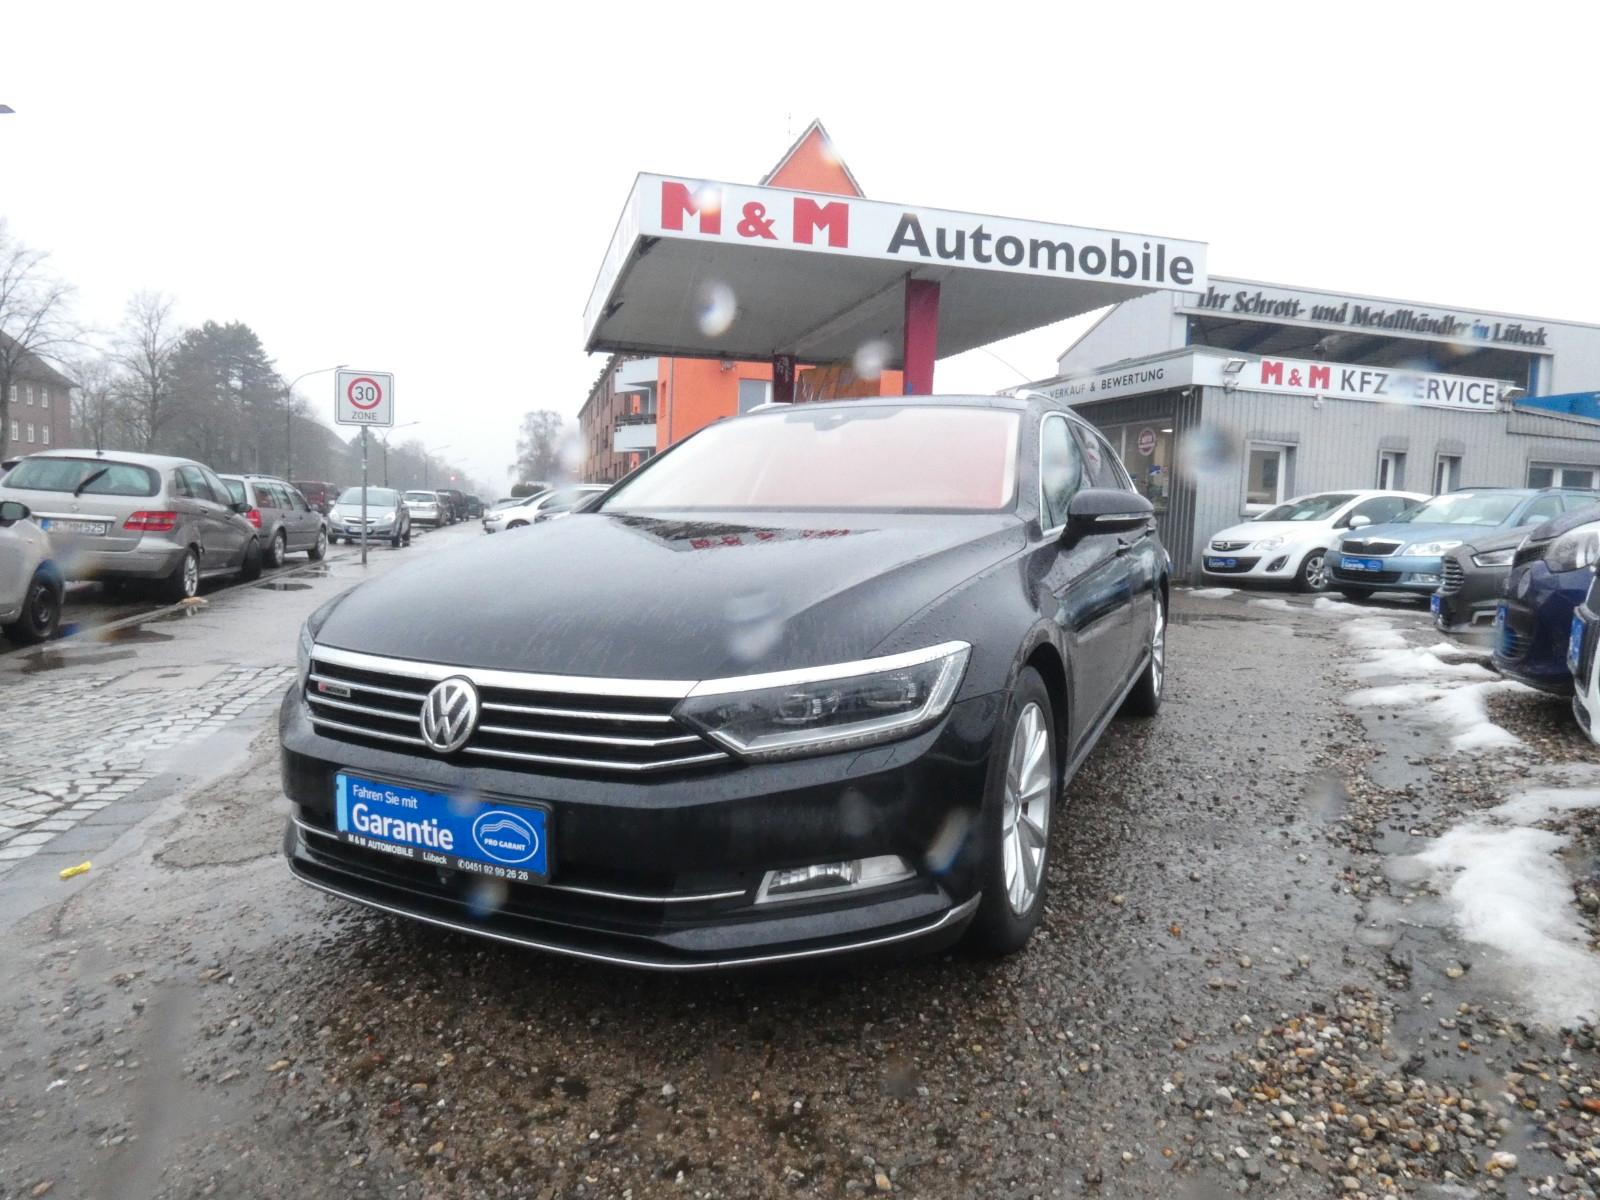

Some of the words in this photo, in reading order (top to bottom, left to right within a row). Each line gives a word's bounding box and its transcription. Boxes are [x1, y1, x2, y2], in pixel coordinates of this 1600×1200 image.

[661, 181, 721, 235] M
[736, 201, 778, 240] &
[792, 197, 849, 248] M
[887, 212, 1194, 285] Automobile
[1233, 291, 1306, 317] Schrott-
[1311, 302, 1349, 323] und
[1491, 322, 1548, 345] Lübeck
[354, 385, 375, 401] 30
[1089, 382, 1096, 391] &
[1101, 368, 1164, 390] BEWERTUNG
[1260, 360, 1284, 385] M
[1287, 368, 1303, 387] &
[1308, 365, 1330, 389] M
[1340, 369, 1389, 394] KFZ
[1398, 376, 1496, 405] ERVICE
[352, 411, 377, 421] ZONE
[352, 784, 383, 802] Fahren
[385, 791, 400, 805] Sie
[401, 796, 418, 809] mit
[352, 803, 454, 850] Garantie
[347, 834, 354, 842] M
[360, 837, 366, 846] M
[367, 839, 414, 857] AUTOMOBILE
[423, 851, 448, 865] Lübeck
[518, 870, 529, 880] 26
[484, 838, 498, 847] PRO
[498, 840, 526, 851] GARANT
